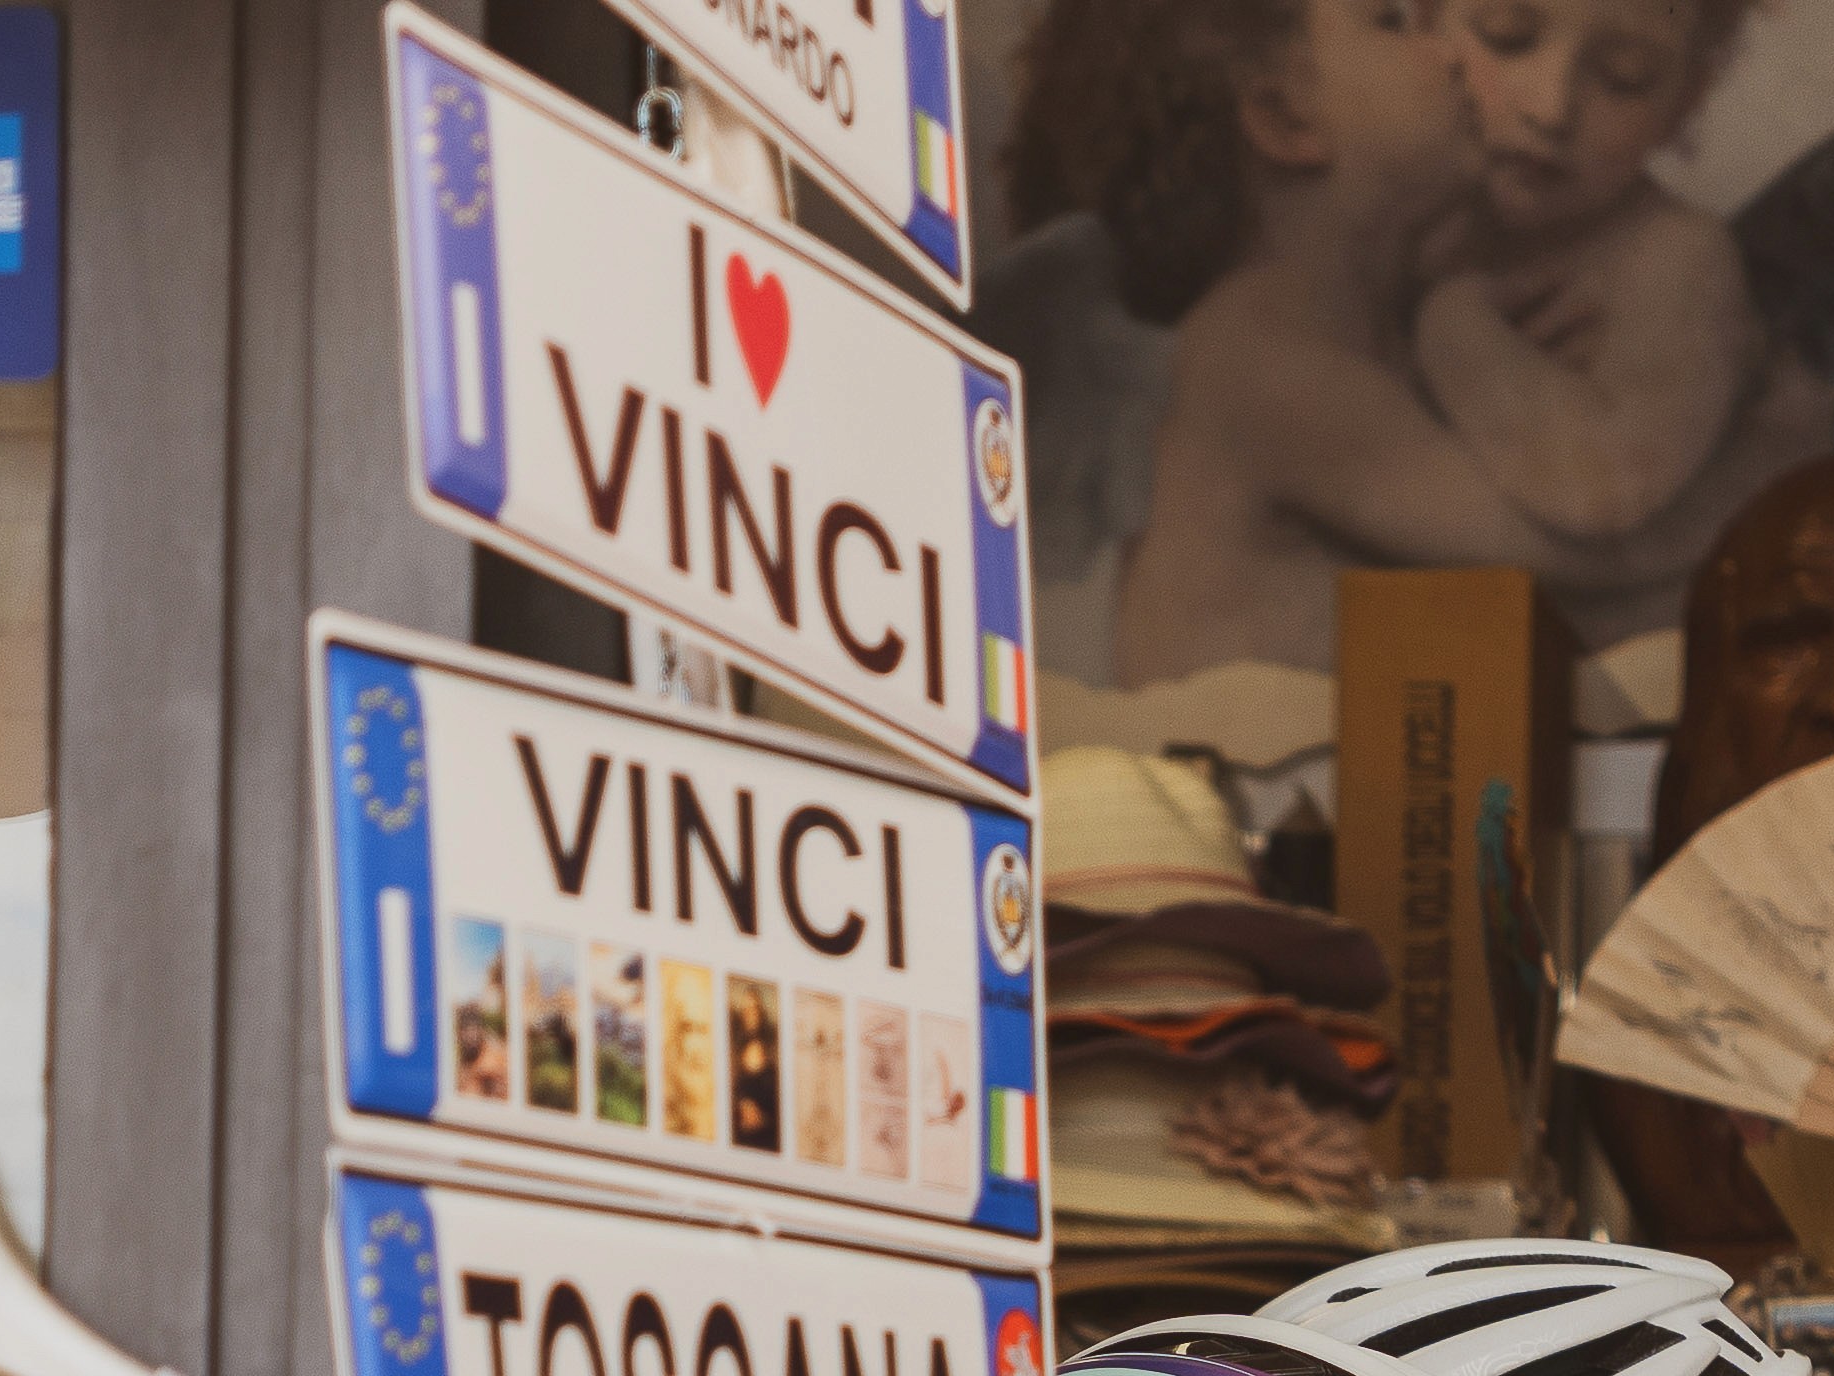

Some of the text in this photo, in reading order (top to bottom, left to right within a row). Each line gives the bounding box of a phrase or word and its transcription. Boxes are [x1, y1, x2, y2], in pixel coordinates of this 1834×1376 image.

[686, 222, 712, 390] I
[545, 340, 947, 708] VINCI
[512, 733, 910, 973] VINCI
